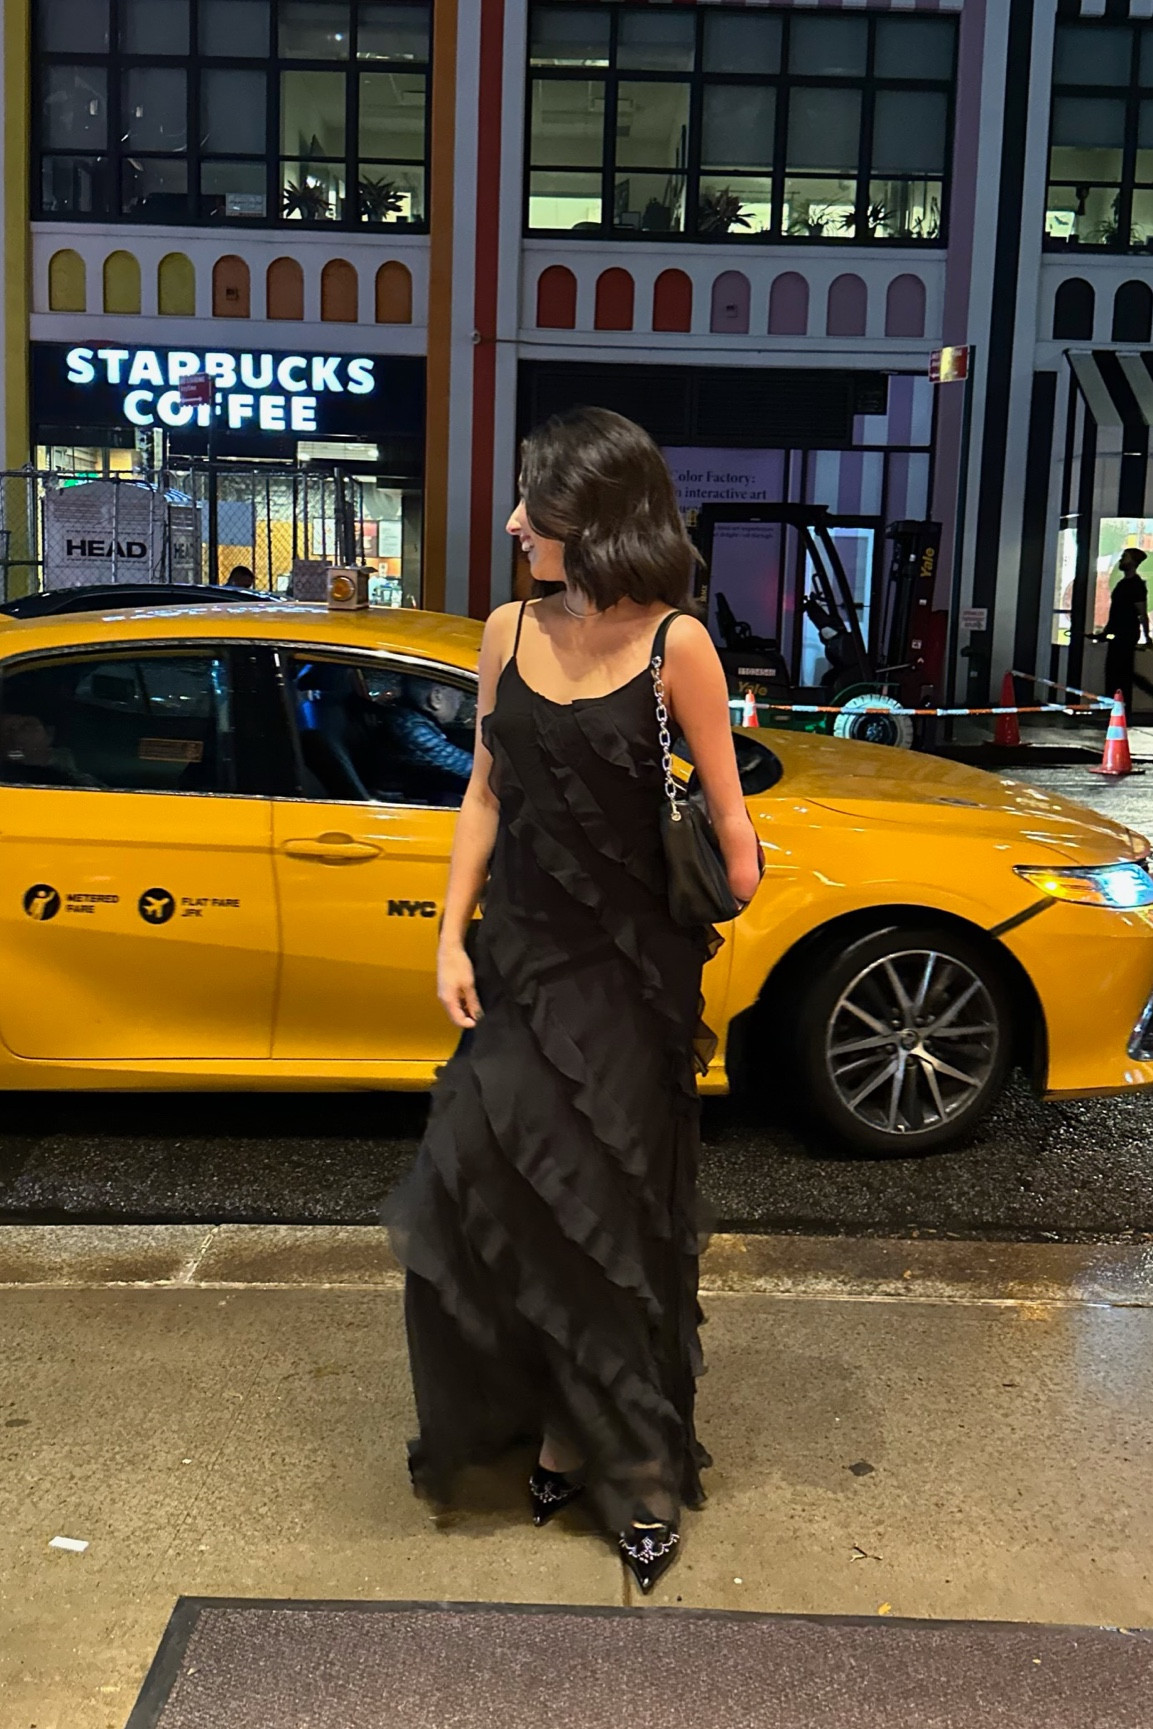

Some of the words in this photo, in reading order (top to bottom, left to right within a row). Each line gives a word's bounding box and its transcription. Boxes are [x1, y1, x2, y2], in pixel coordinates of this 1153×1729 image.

[66, 347, 375, 394] STARBUCKS
[706, 471, 756, 487] Factory:
[685, 487, 748, 500] interactive
[750, 489, 767, 501] art
[66, 539, 147, 559] HEAD
[920, 547, 936, 577] Yale
[66, 893, 120, 904] METERED
[181, 897, 208, 907] FLAT
[212, 898, 241, 908] FARE
[66, 904, 96, 914] FARE
[387, 899, 437, 918] NYC
